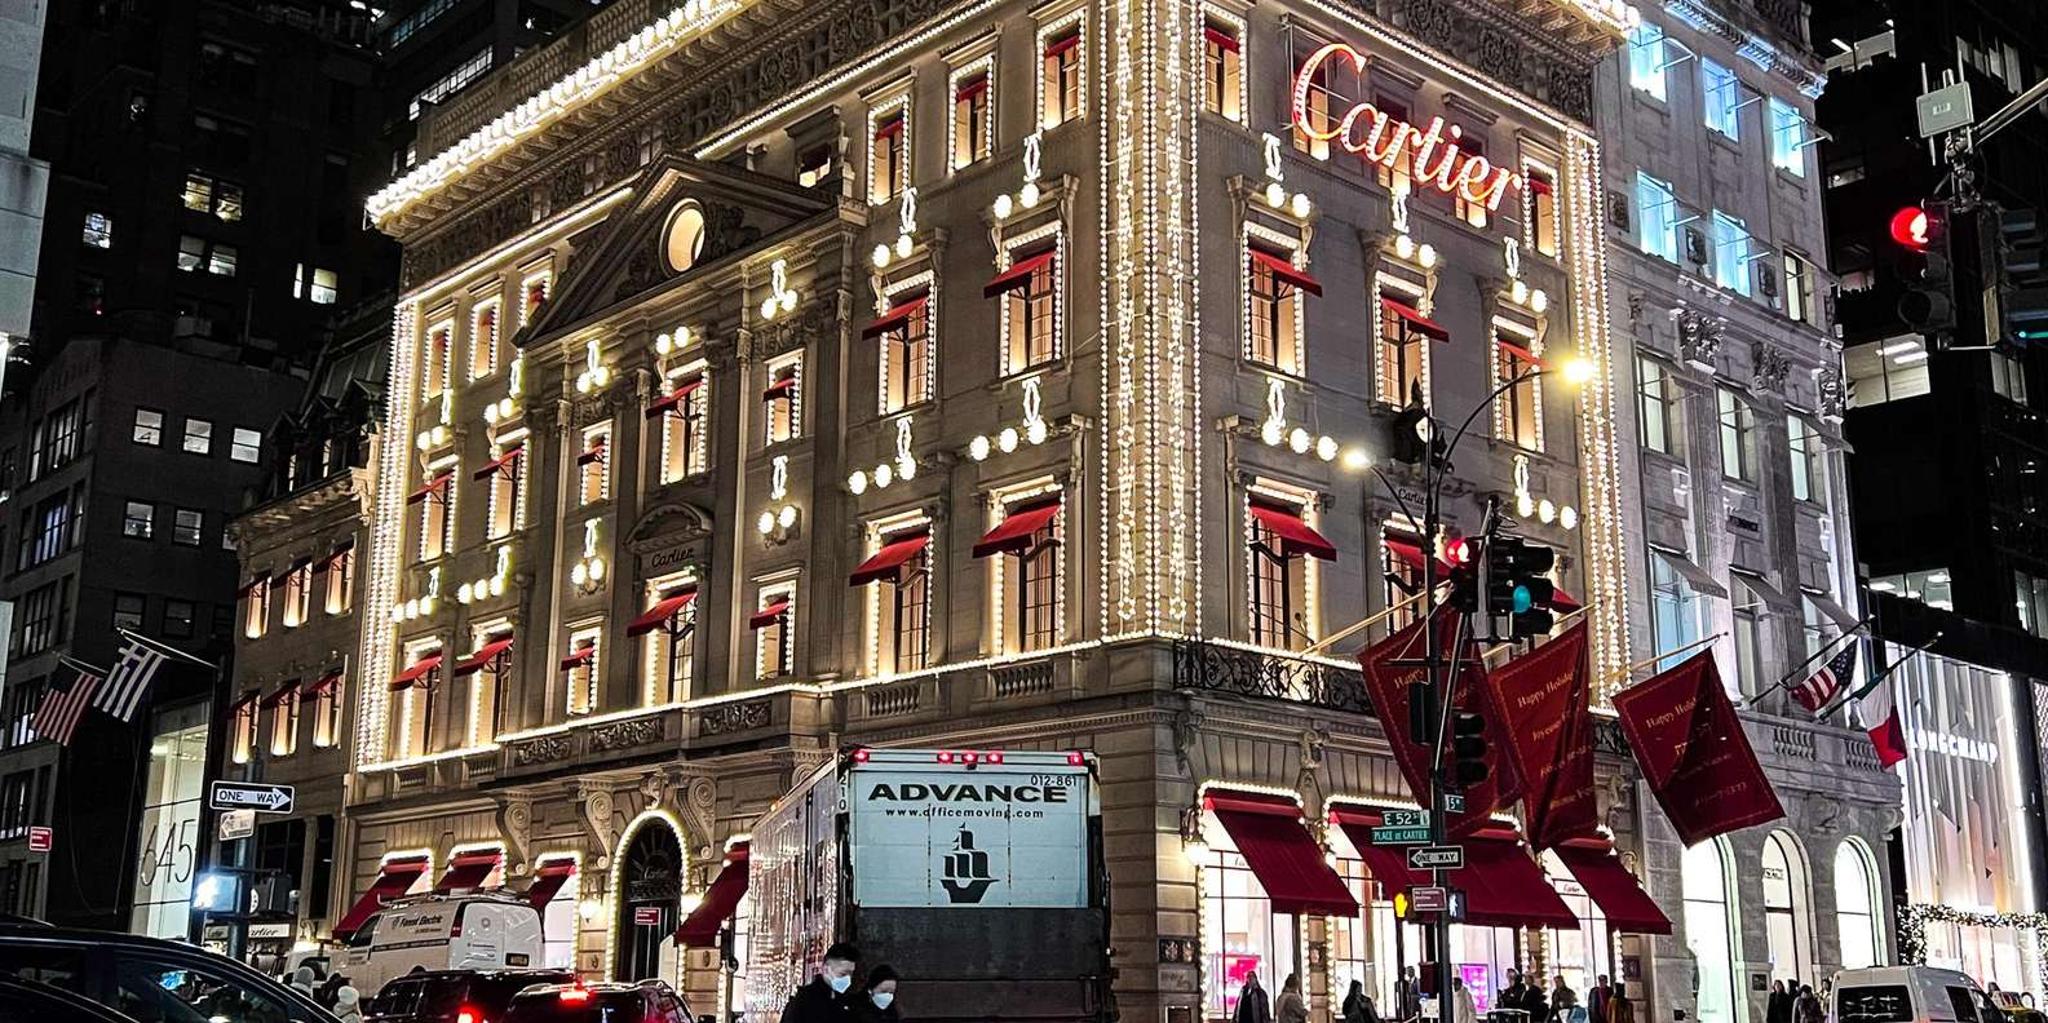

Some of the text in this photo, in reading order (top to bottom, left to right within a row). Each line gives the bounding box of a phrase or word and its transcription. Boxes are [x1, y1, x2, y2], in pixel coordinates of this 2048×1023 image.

[1294, 43, 1523, 211] Cartier
[651, 546, 695, 568] Cartier
[1517, 689, 1545, 708] Happy
[1645, 711, 1675, 729] Happy
[1909, 726, 1998, 767] LONGCHAMP
[1030, 775, 1077, 787] 012-861
[219, 790, 282, 804] ONE WAY
[868, 783, 1068, 803] ADVANCE
[886, 806, 1044, 820] www.officemoving.com
[1384, 813, 1392, 825] E
[1396, 812, 1412, 825] 52
[141, 818, 196, 887] 645
[1416, 853, 1456, 863] ONE WAY
